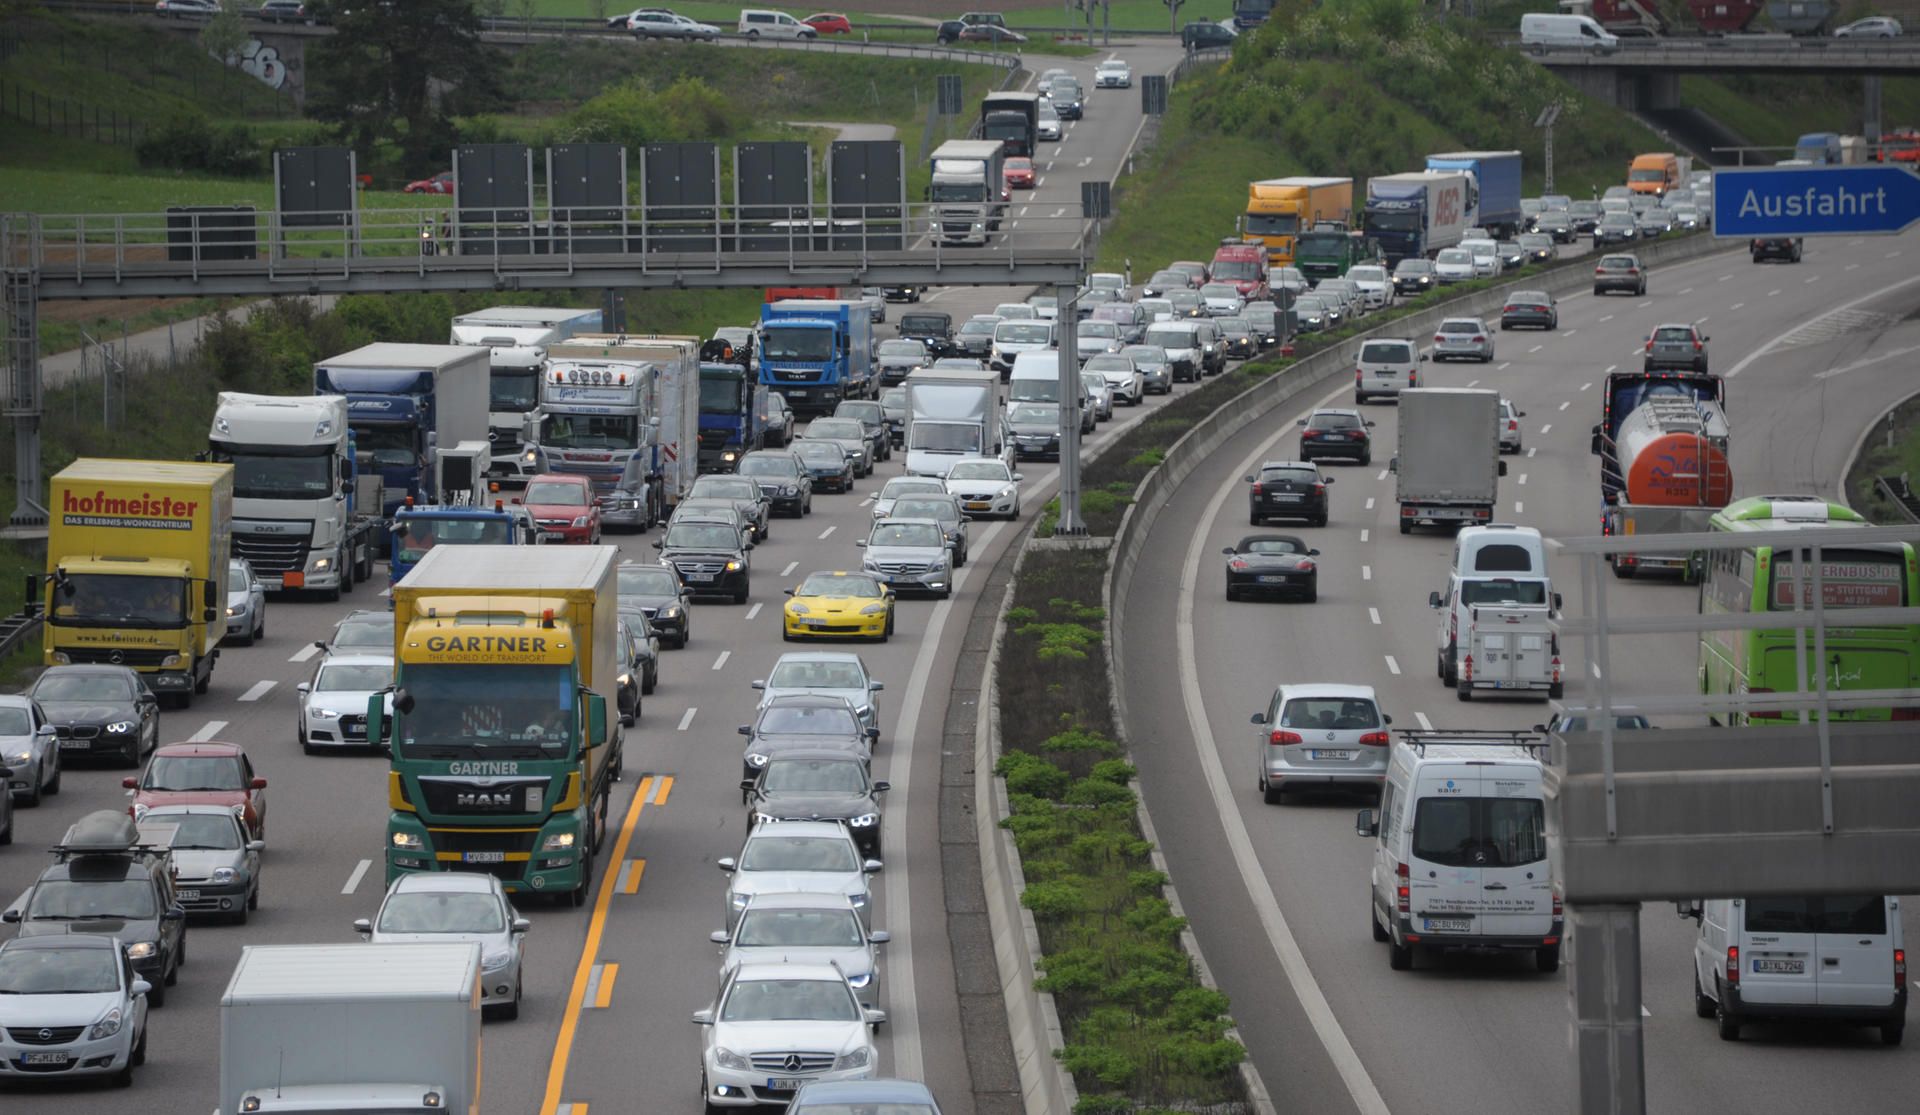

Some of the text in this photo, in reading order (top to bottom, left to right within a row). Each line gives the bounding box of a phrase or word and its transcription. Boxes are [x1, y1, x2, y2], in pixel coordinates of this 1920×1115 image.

[1738, 186, 1887, 218] Ausfahrt
[63, 490, 197, 517] hofmeister
[65, 517, 82, 525] DAS
[427, 636, 546, 652] GARTNER
[428, 653, 547, 662] THE WORLD OF TRANSPORT
[449, 762, 519, 775] GARTNER
[458, 793, 511, 805] MAN
